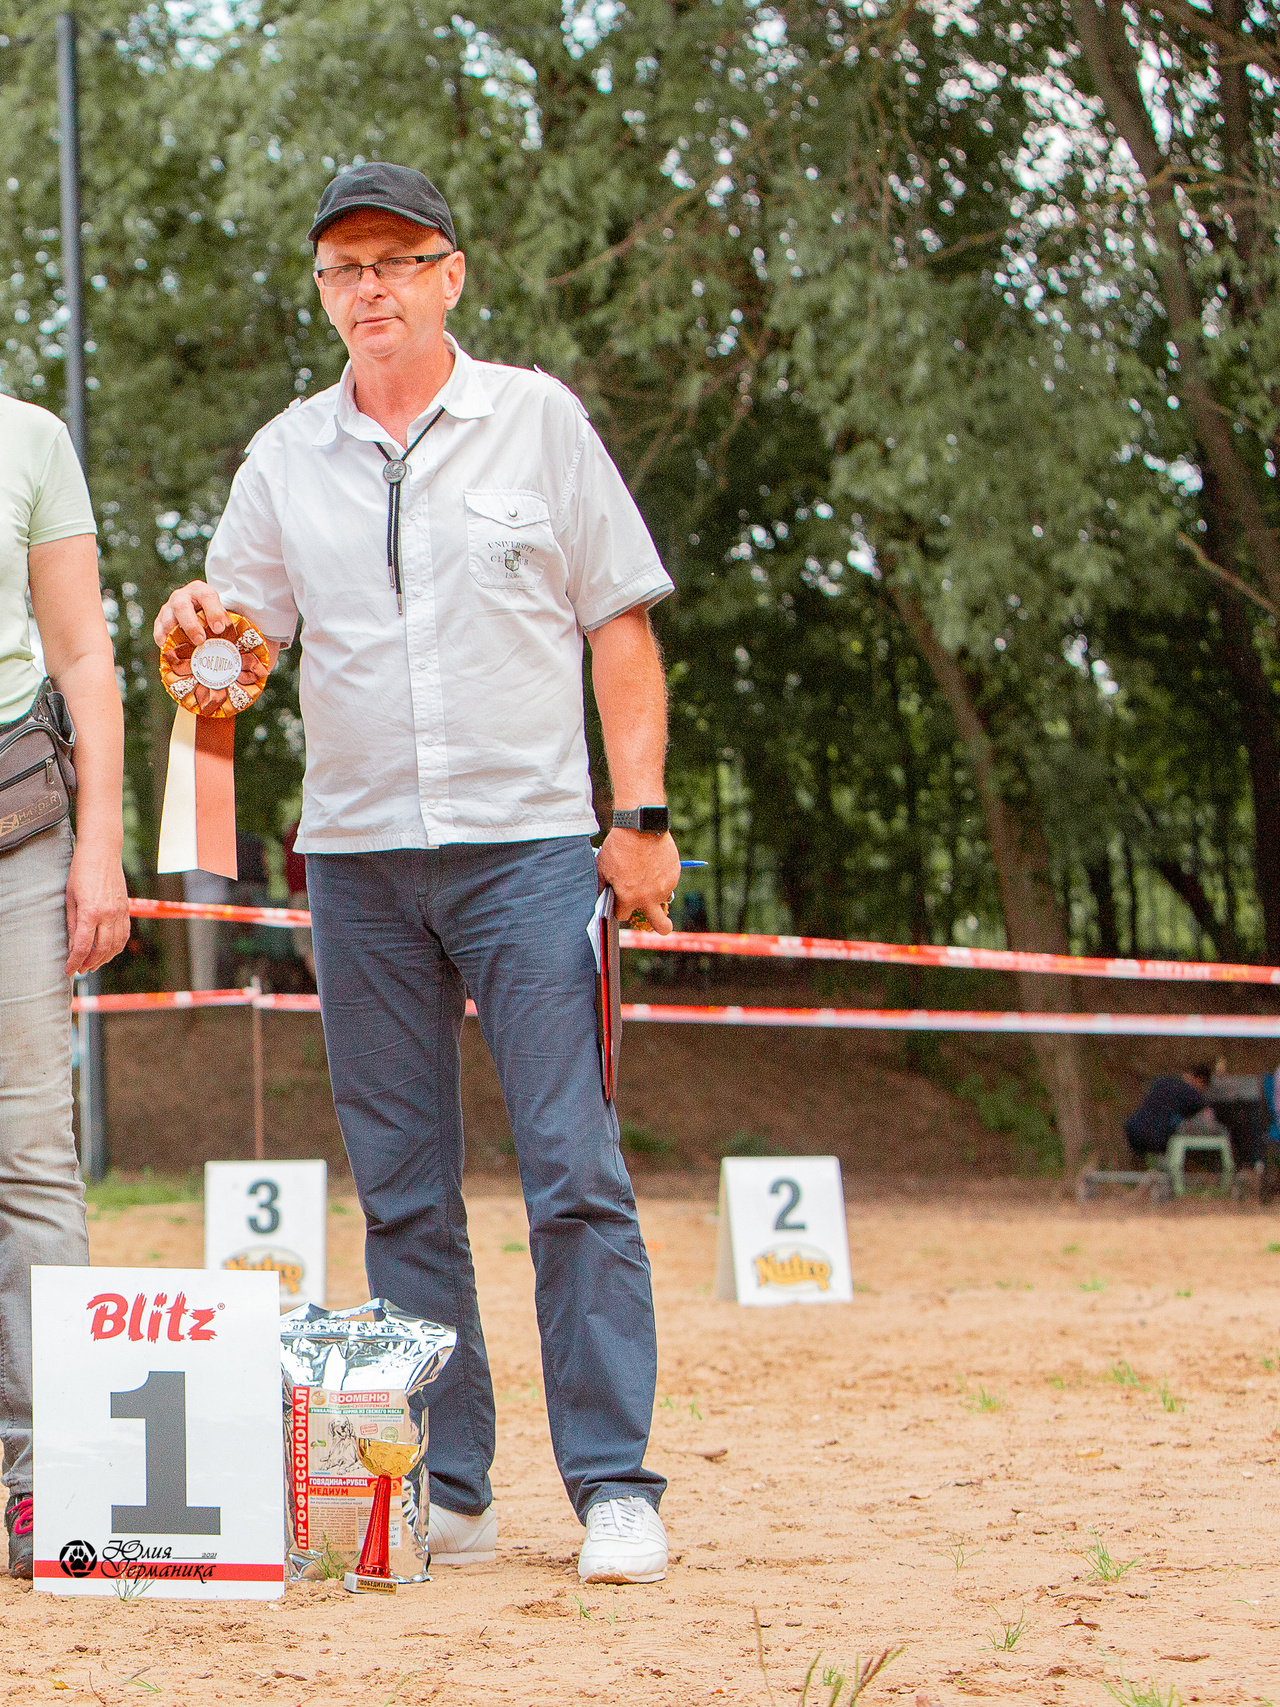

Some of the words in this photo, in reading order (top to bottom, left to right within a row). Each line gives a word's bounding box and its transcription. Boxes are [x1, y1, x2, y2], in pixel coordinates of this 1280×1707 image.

[247, 1179, 280, 1234] 3
[770, 1177, 807, 1231] 2
[86, 1291, 218, 1344] Blitz
[330, 1393, 388, 1403] ЗООМЕНЮ
[110, 1371, 221, 1535] 1
[295, 1389, 308, 1548] ПРОФЕССИОНАЛ
[309, 1487, 349, 1496] МЕДИУМ
